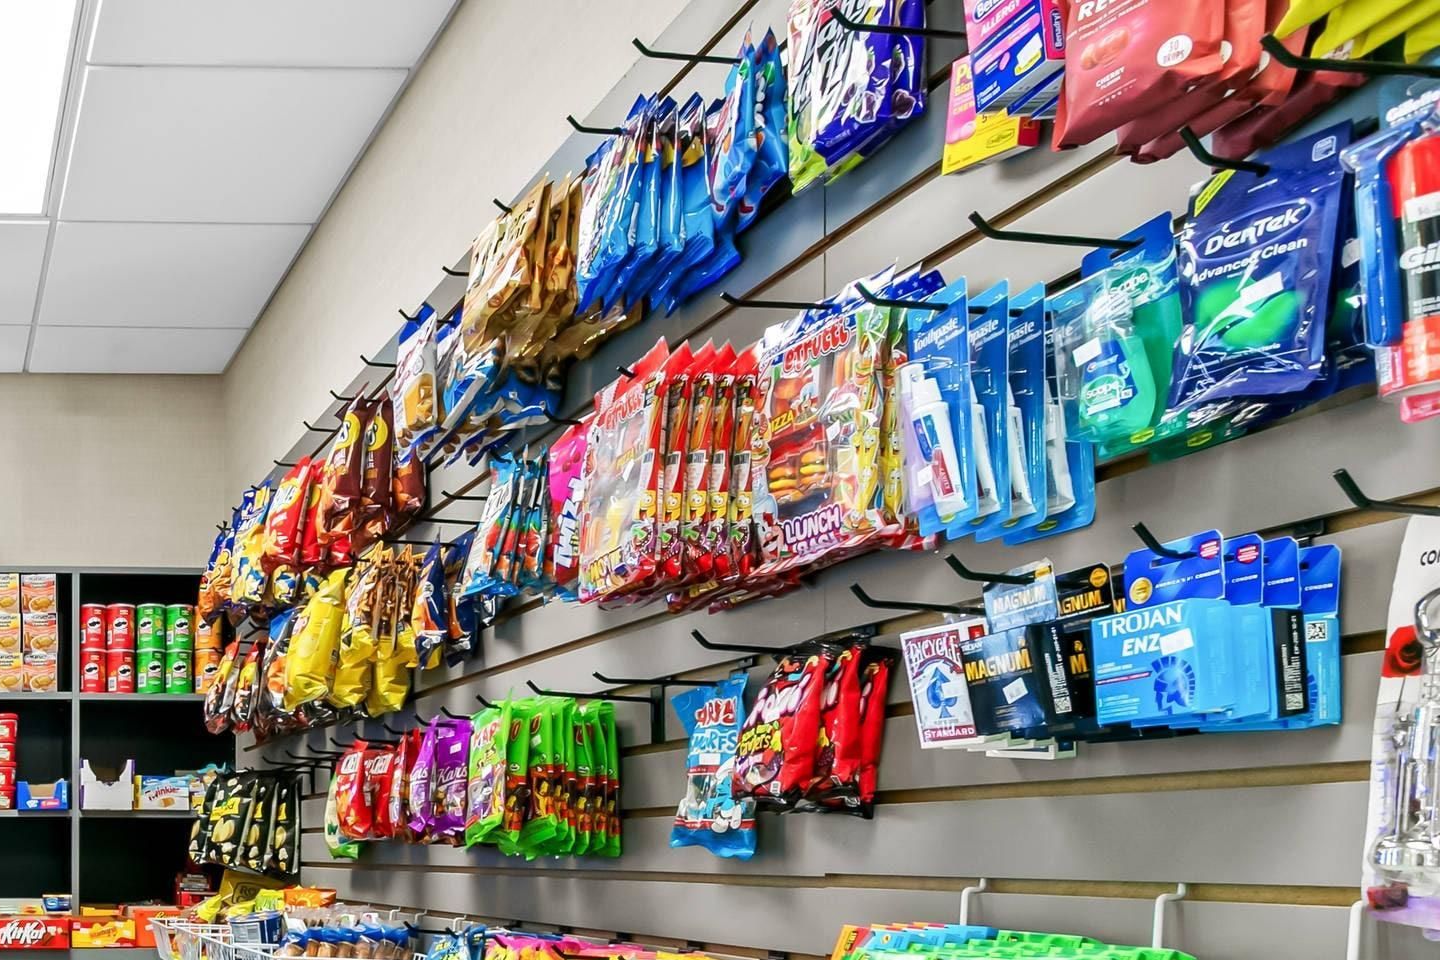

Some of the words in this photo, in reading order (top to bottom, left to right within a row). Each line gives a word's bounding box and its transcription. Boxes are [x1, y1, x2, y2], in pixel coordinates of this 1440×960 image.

[1051, 12, 1062, 48] Benadryl
[1162, 50, 1185, 64] DROPS
[1095, 66, 1125, 87] CHERRY
[1204, 205, 1302, 256] DenTek
[1190, 251, 1261, 287] Advanced
[1262, 237, 1309, 260] Clean
[913, 316, 959, 353] Toothpaste
[1086, 379, 1122, 400] scope
[783, 504, 841, 544] LUNCH
[1154, 577, 1186, 589] AMERICA'S
[1194, 568, 1221, 581] CONDOM
[1231, 573, 1259, 584] CONDOM
[1267, 576, 1295, 586] CONDOM
[1304, 582, 1334, 592] CONDOM
[993, 584, 1047, 615] MAGNUM
[1058, 589, 1104, 616] GNUM
[1098, 603, 1185, 639] TROJAN
[910, 633, 962, 666] BICYCLE
[1121, 632, 1162, 657] ENZ
[965, 648, 1032, 682] MAGNUM
[923, 726, 976, 740] STANDARD
[437, 763, 469, 784] Kar's
